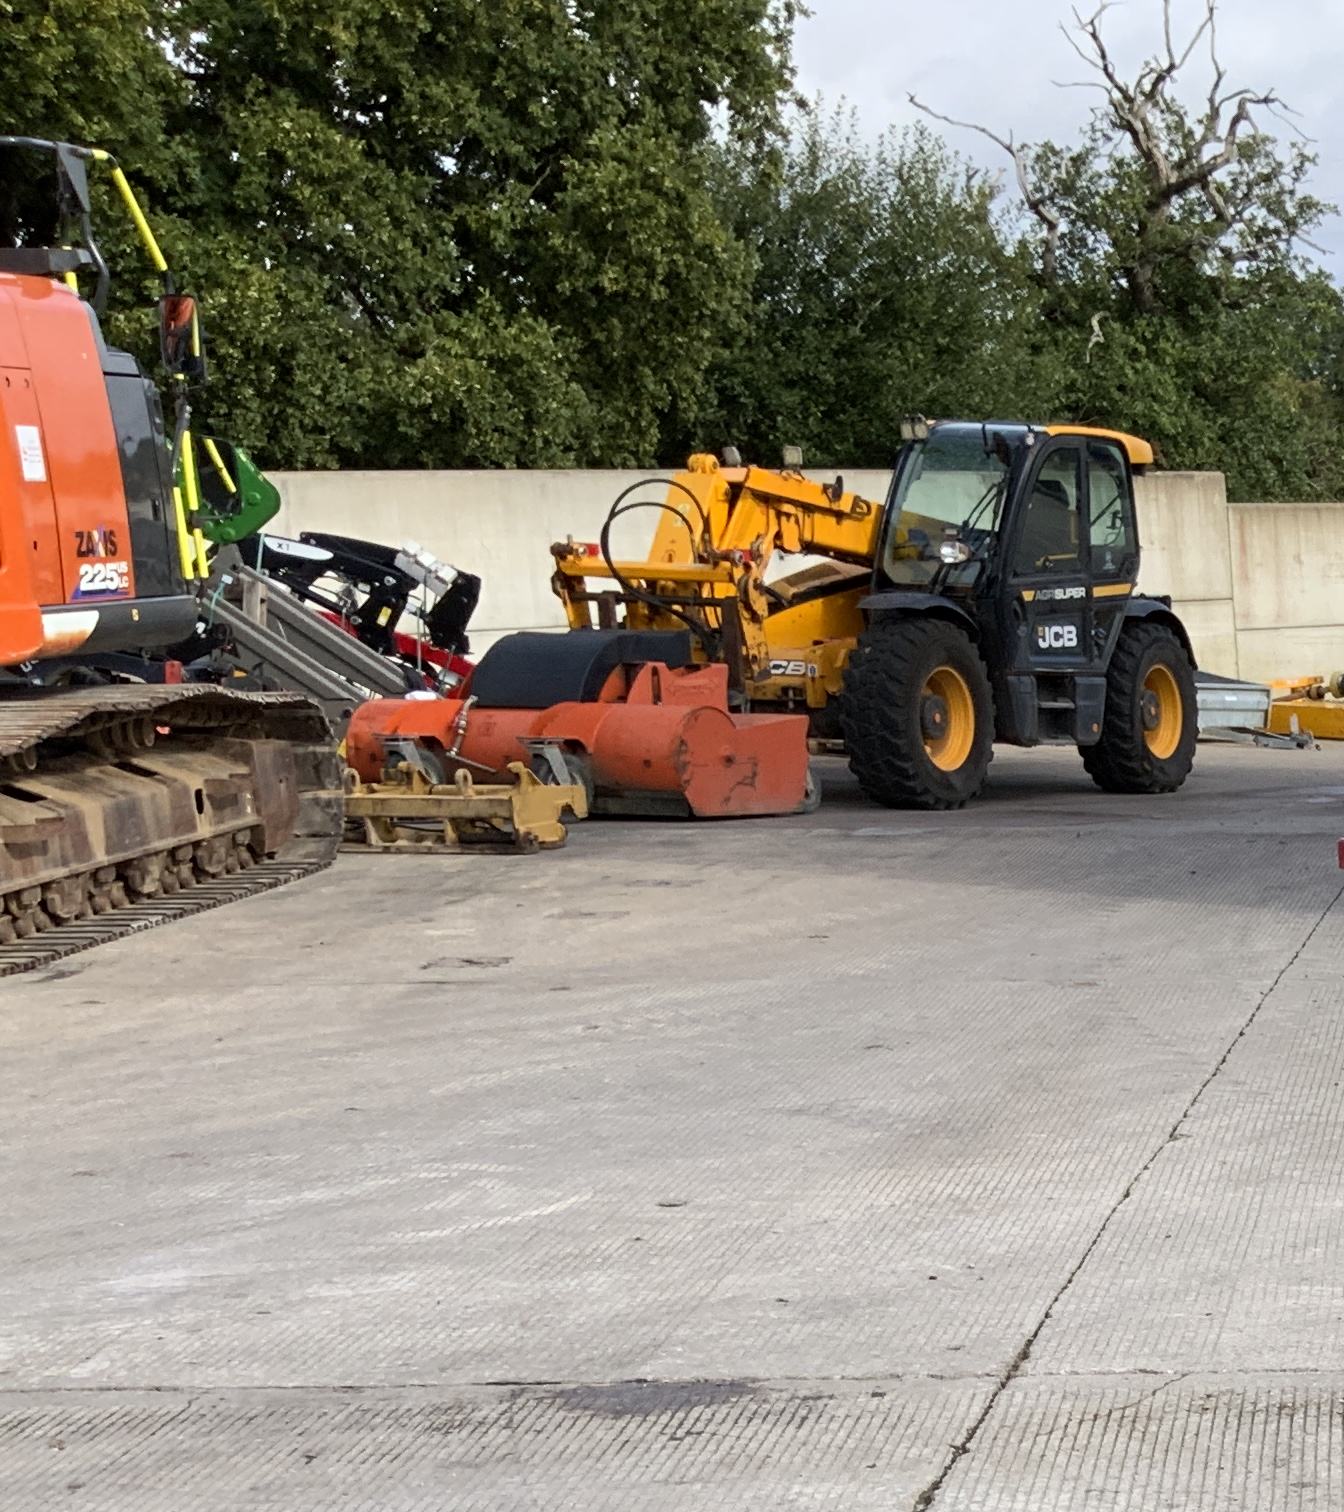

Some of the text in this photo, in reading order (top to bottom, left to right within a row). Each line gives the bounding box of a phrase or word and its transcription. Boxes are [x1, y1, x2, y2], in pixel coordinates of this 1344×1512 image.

[79, 563, 119, 594] 225
[1037, 625, 1078, 649] JCB
[769, 660, 806, 675] CB
